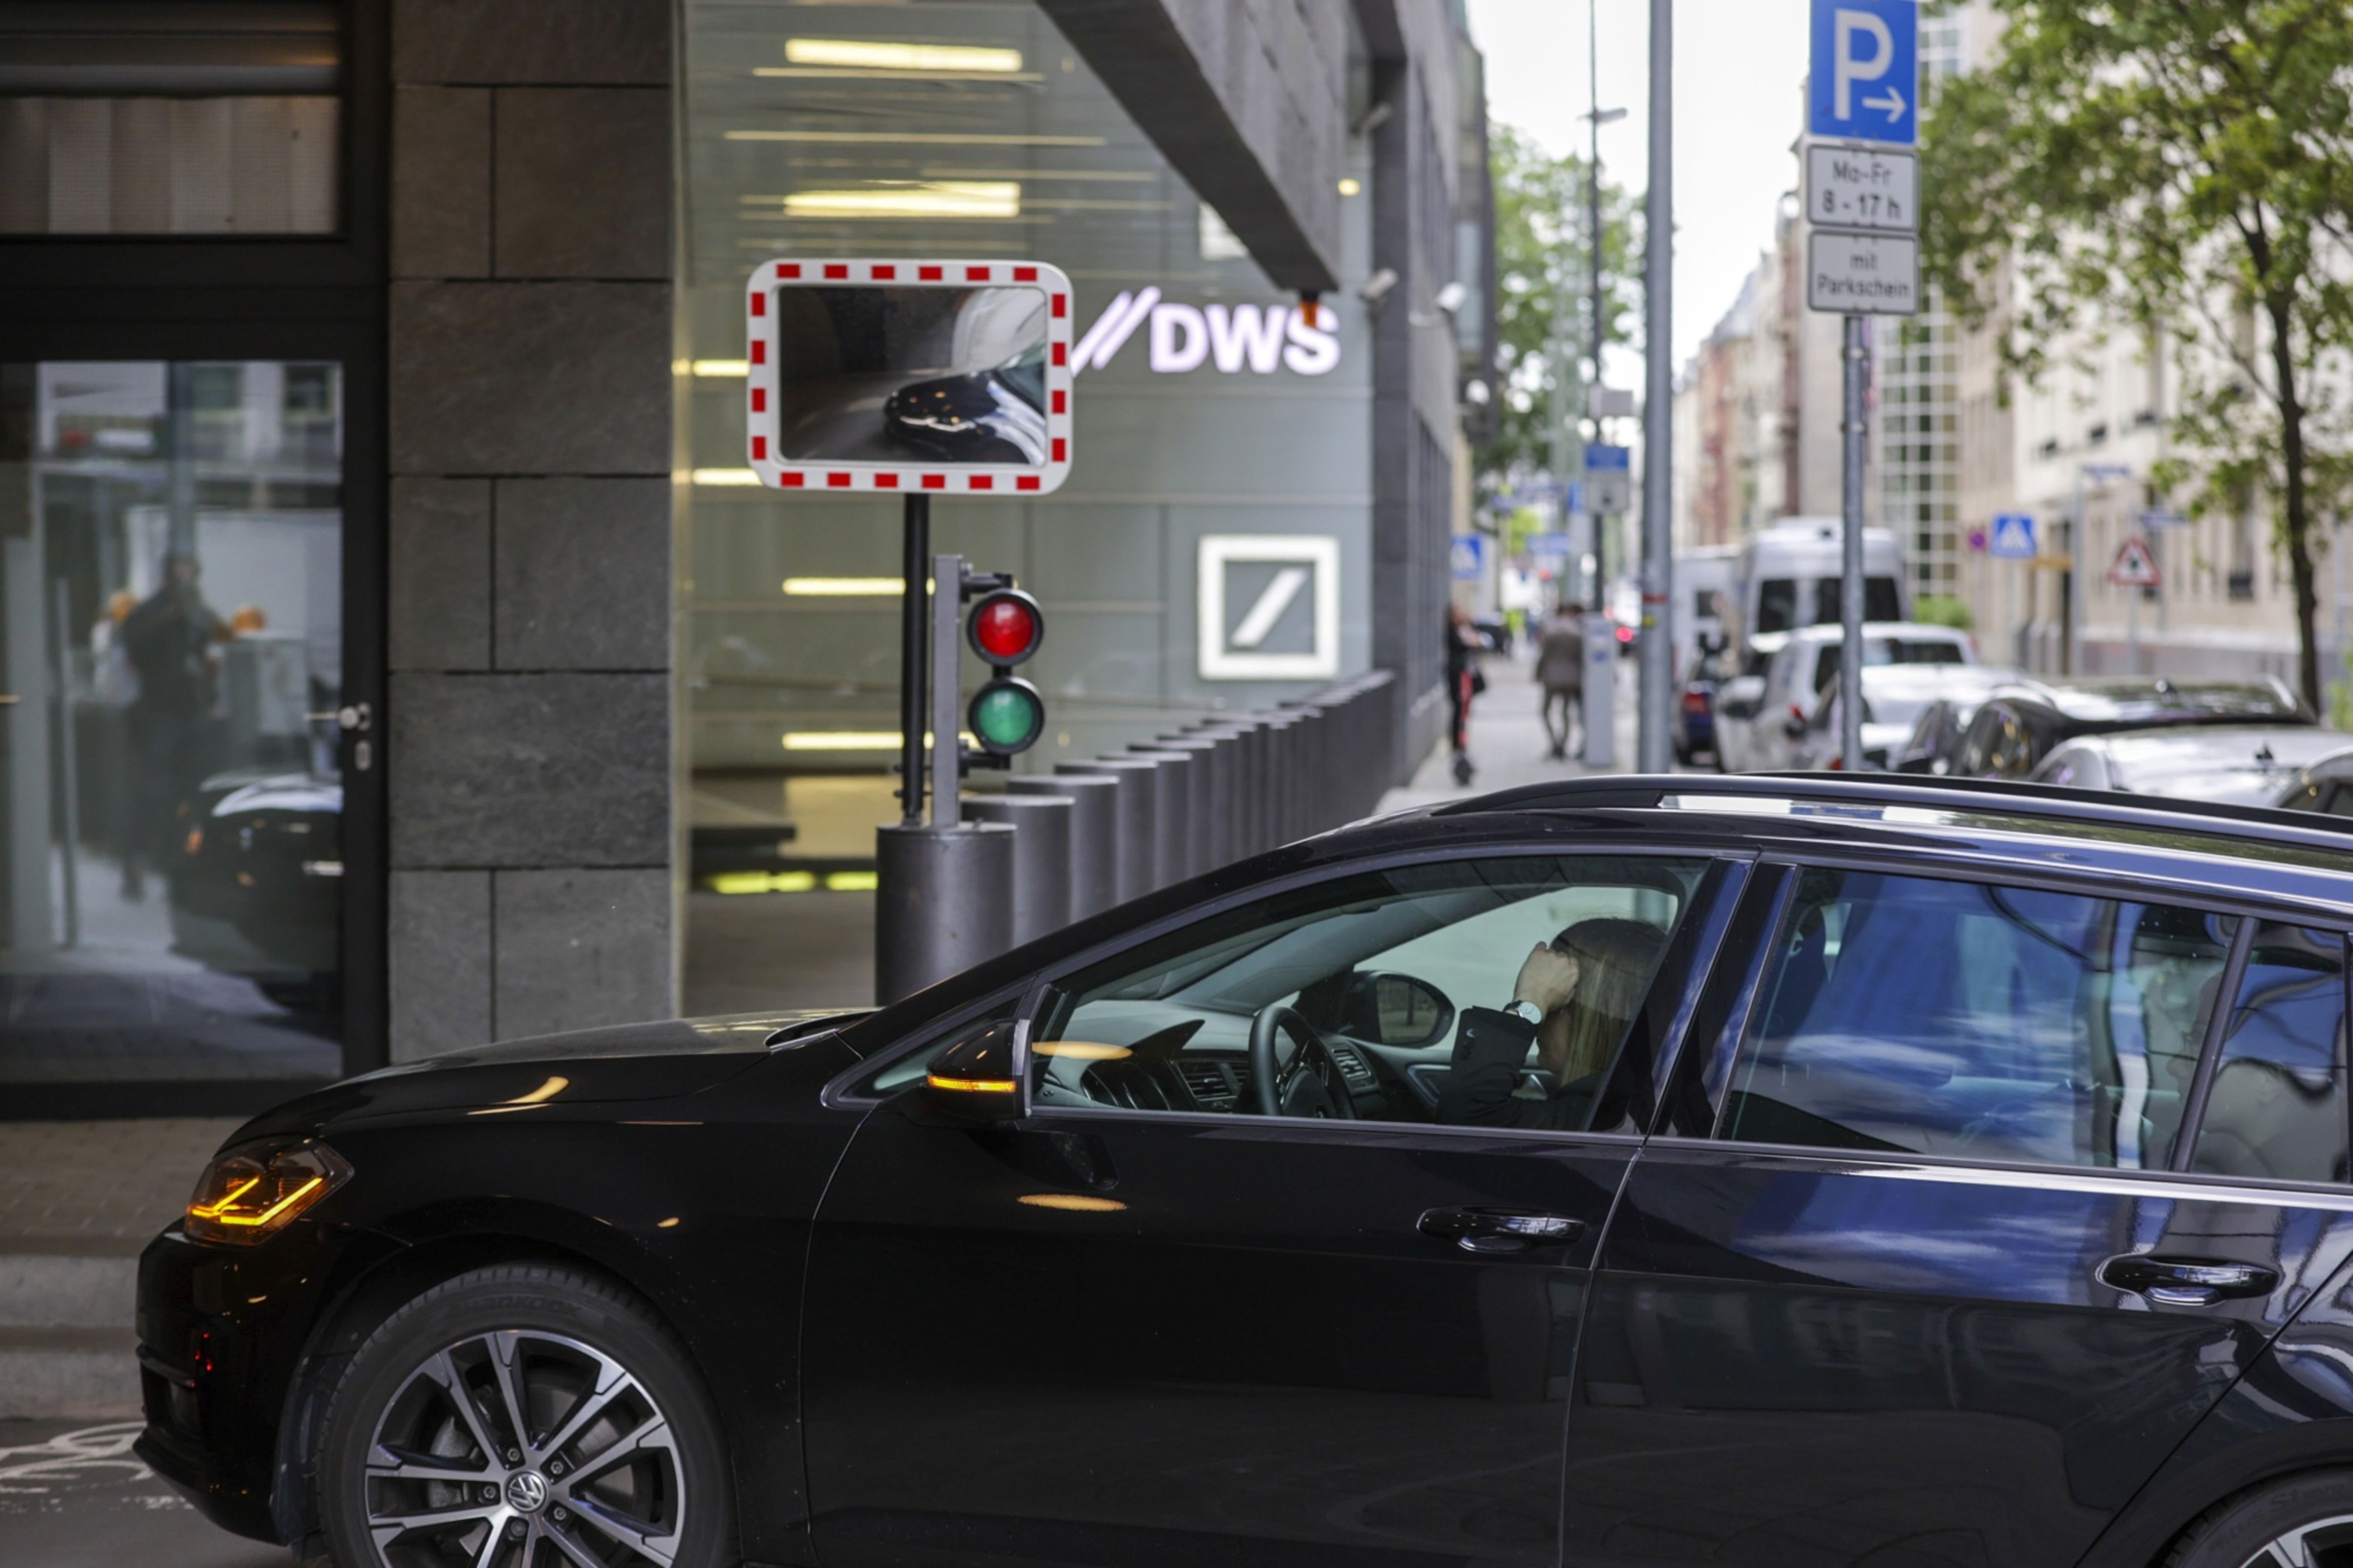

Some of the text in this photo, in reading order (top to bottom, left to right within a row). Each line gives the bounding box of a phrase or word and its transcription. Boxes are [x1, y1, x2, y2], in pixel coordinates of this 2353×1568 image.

[1834, 9, 1893, 121] P
[1832, 161, 1892, 186] Mo-Fr
[1849, 251, 1879, 270] mit
[1817, 272, 1911, 298] Parkschein
[1149, 302, 1342, 375] DWS
